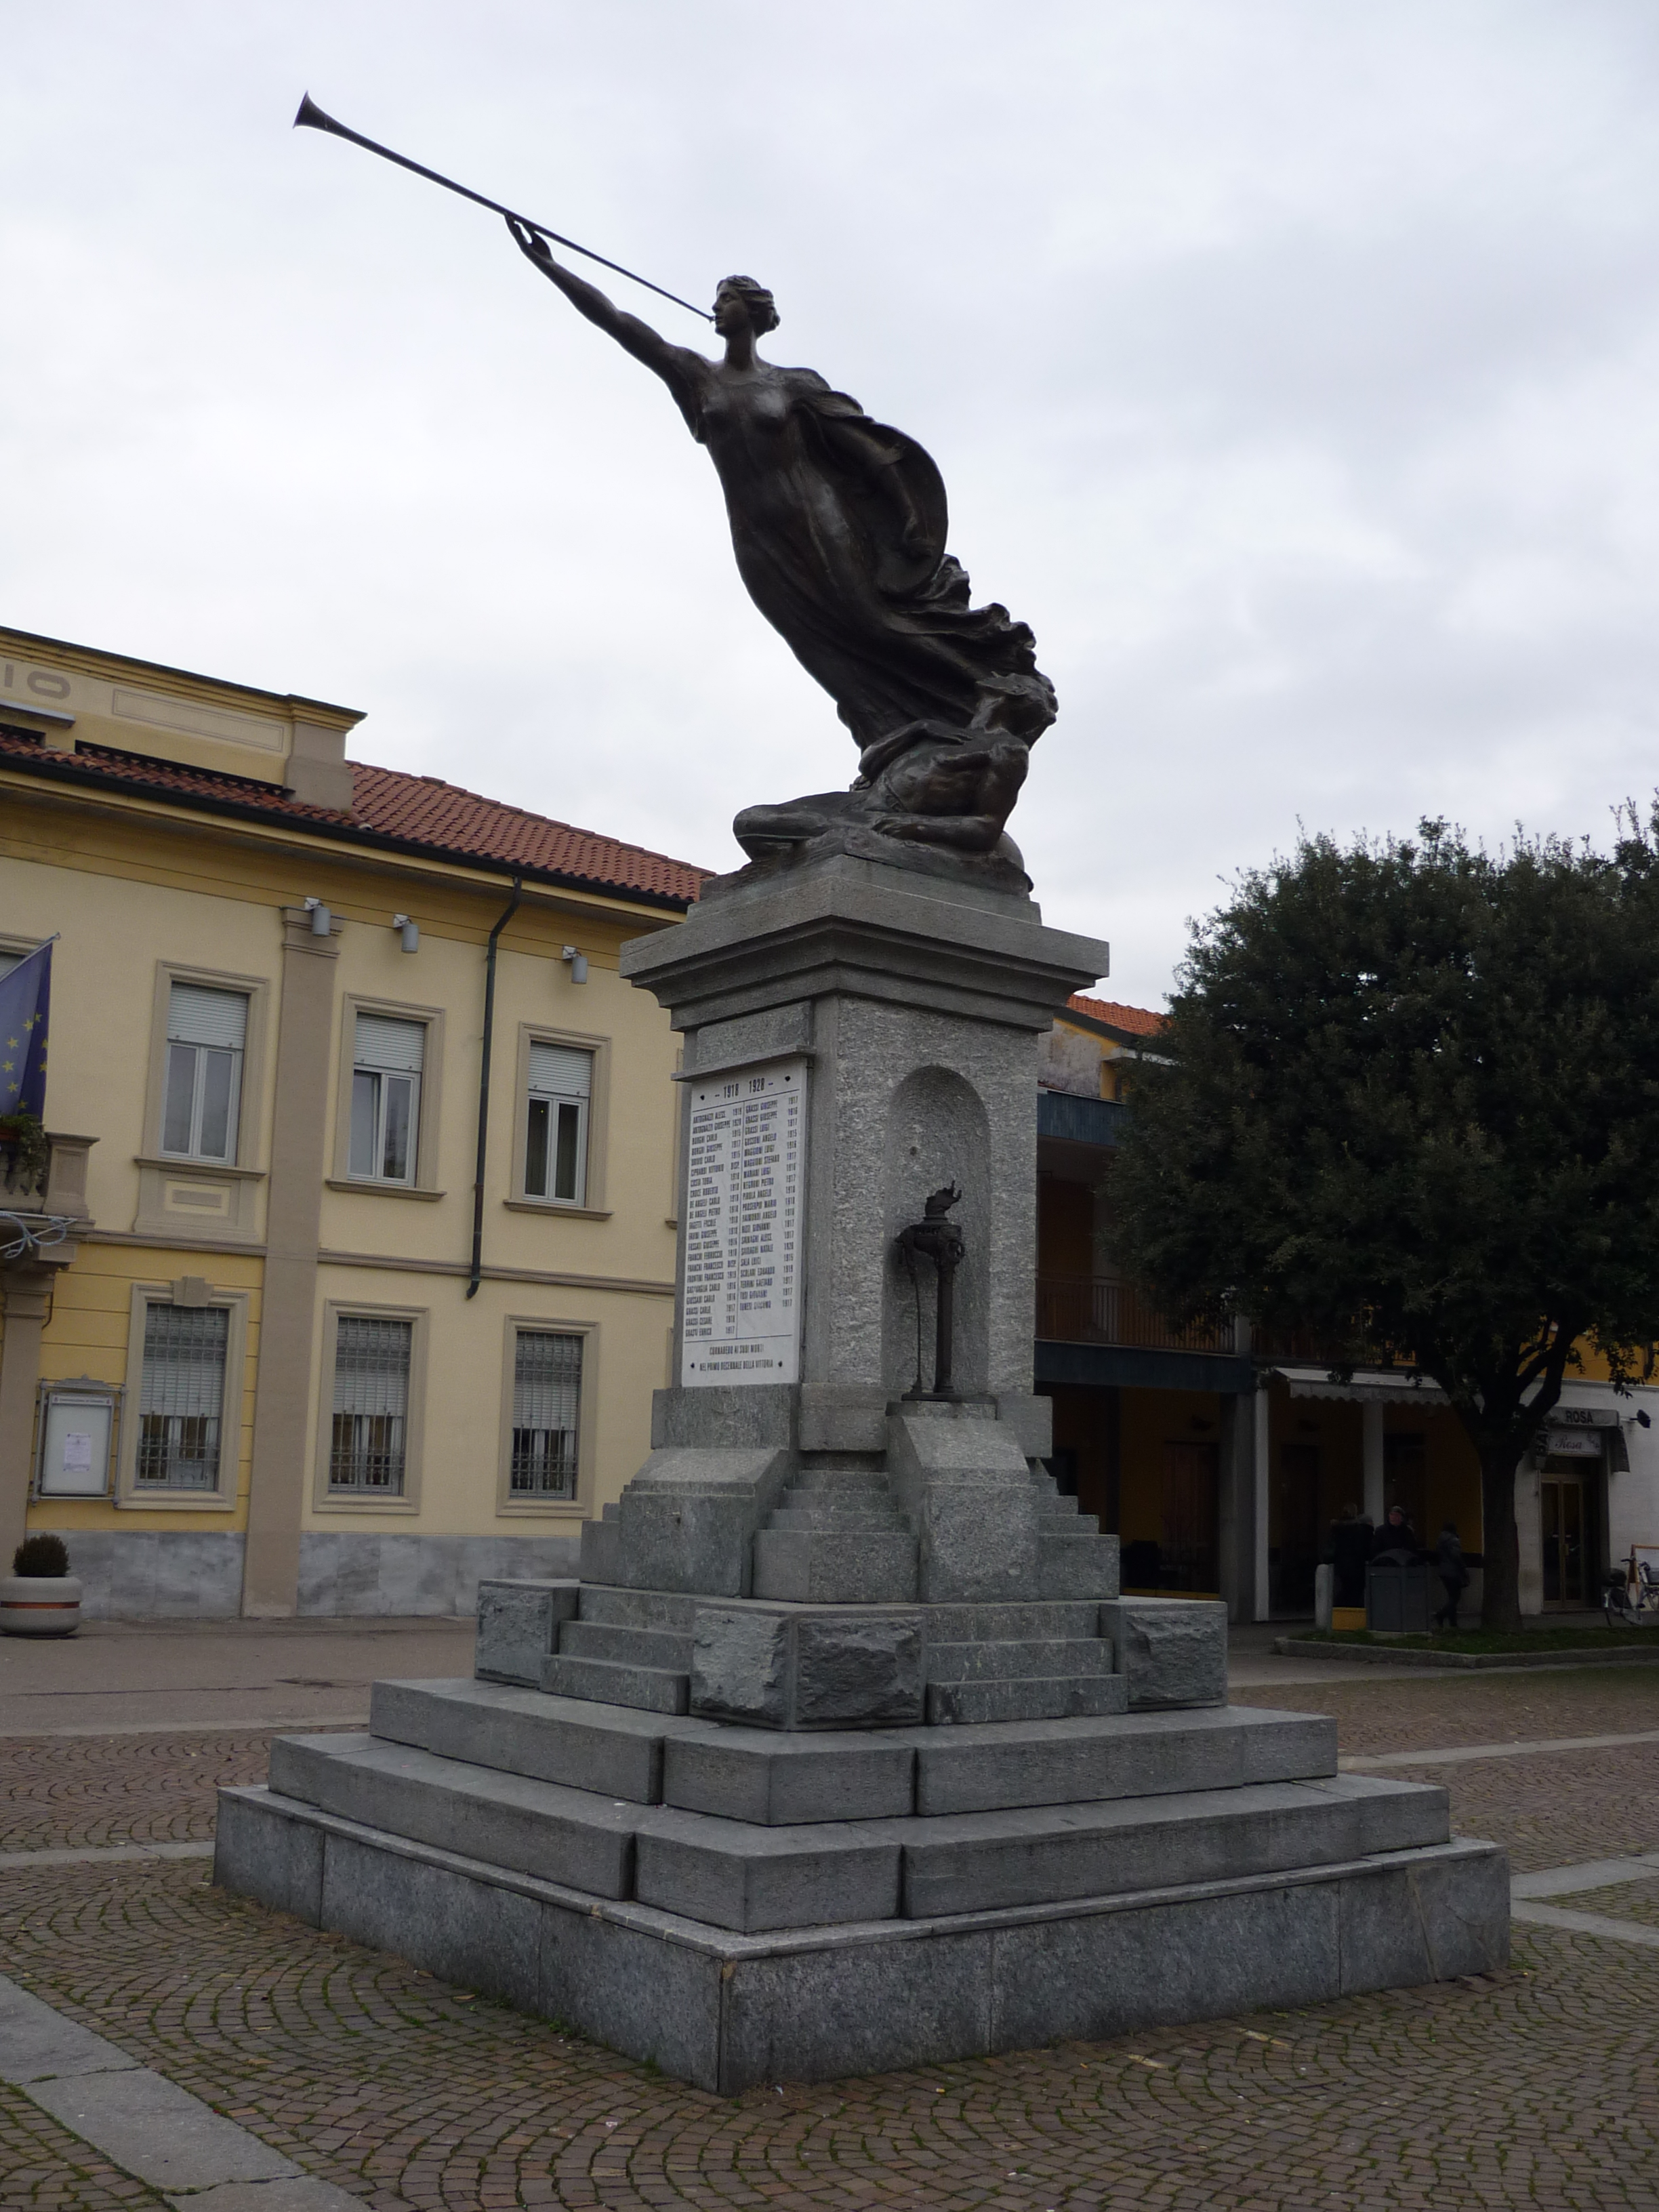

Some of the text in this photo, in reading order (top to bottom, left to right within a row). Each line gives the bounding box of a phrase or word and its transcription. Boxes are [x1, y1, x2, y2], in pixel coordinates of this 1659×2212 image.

[723, 1078, 765, 1099] 1918 1920
[1565, 1410, 1593, 1424] ROSA
